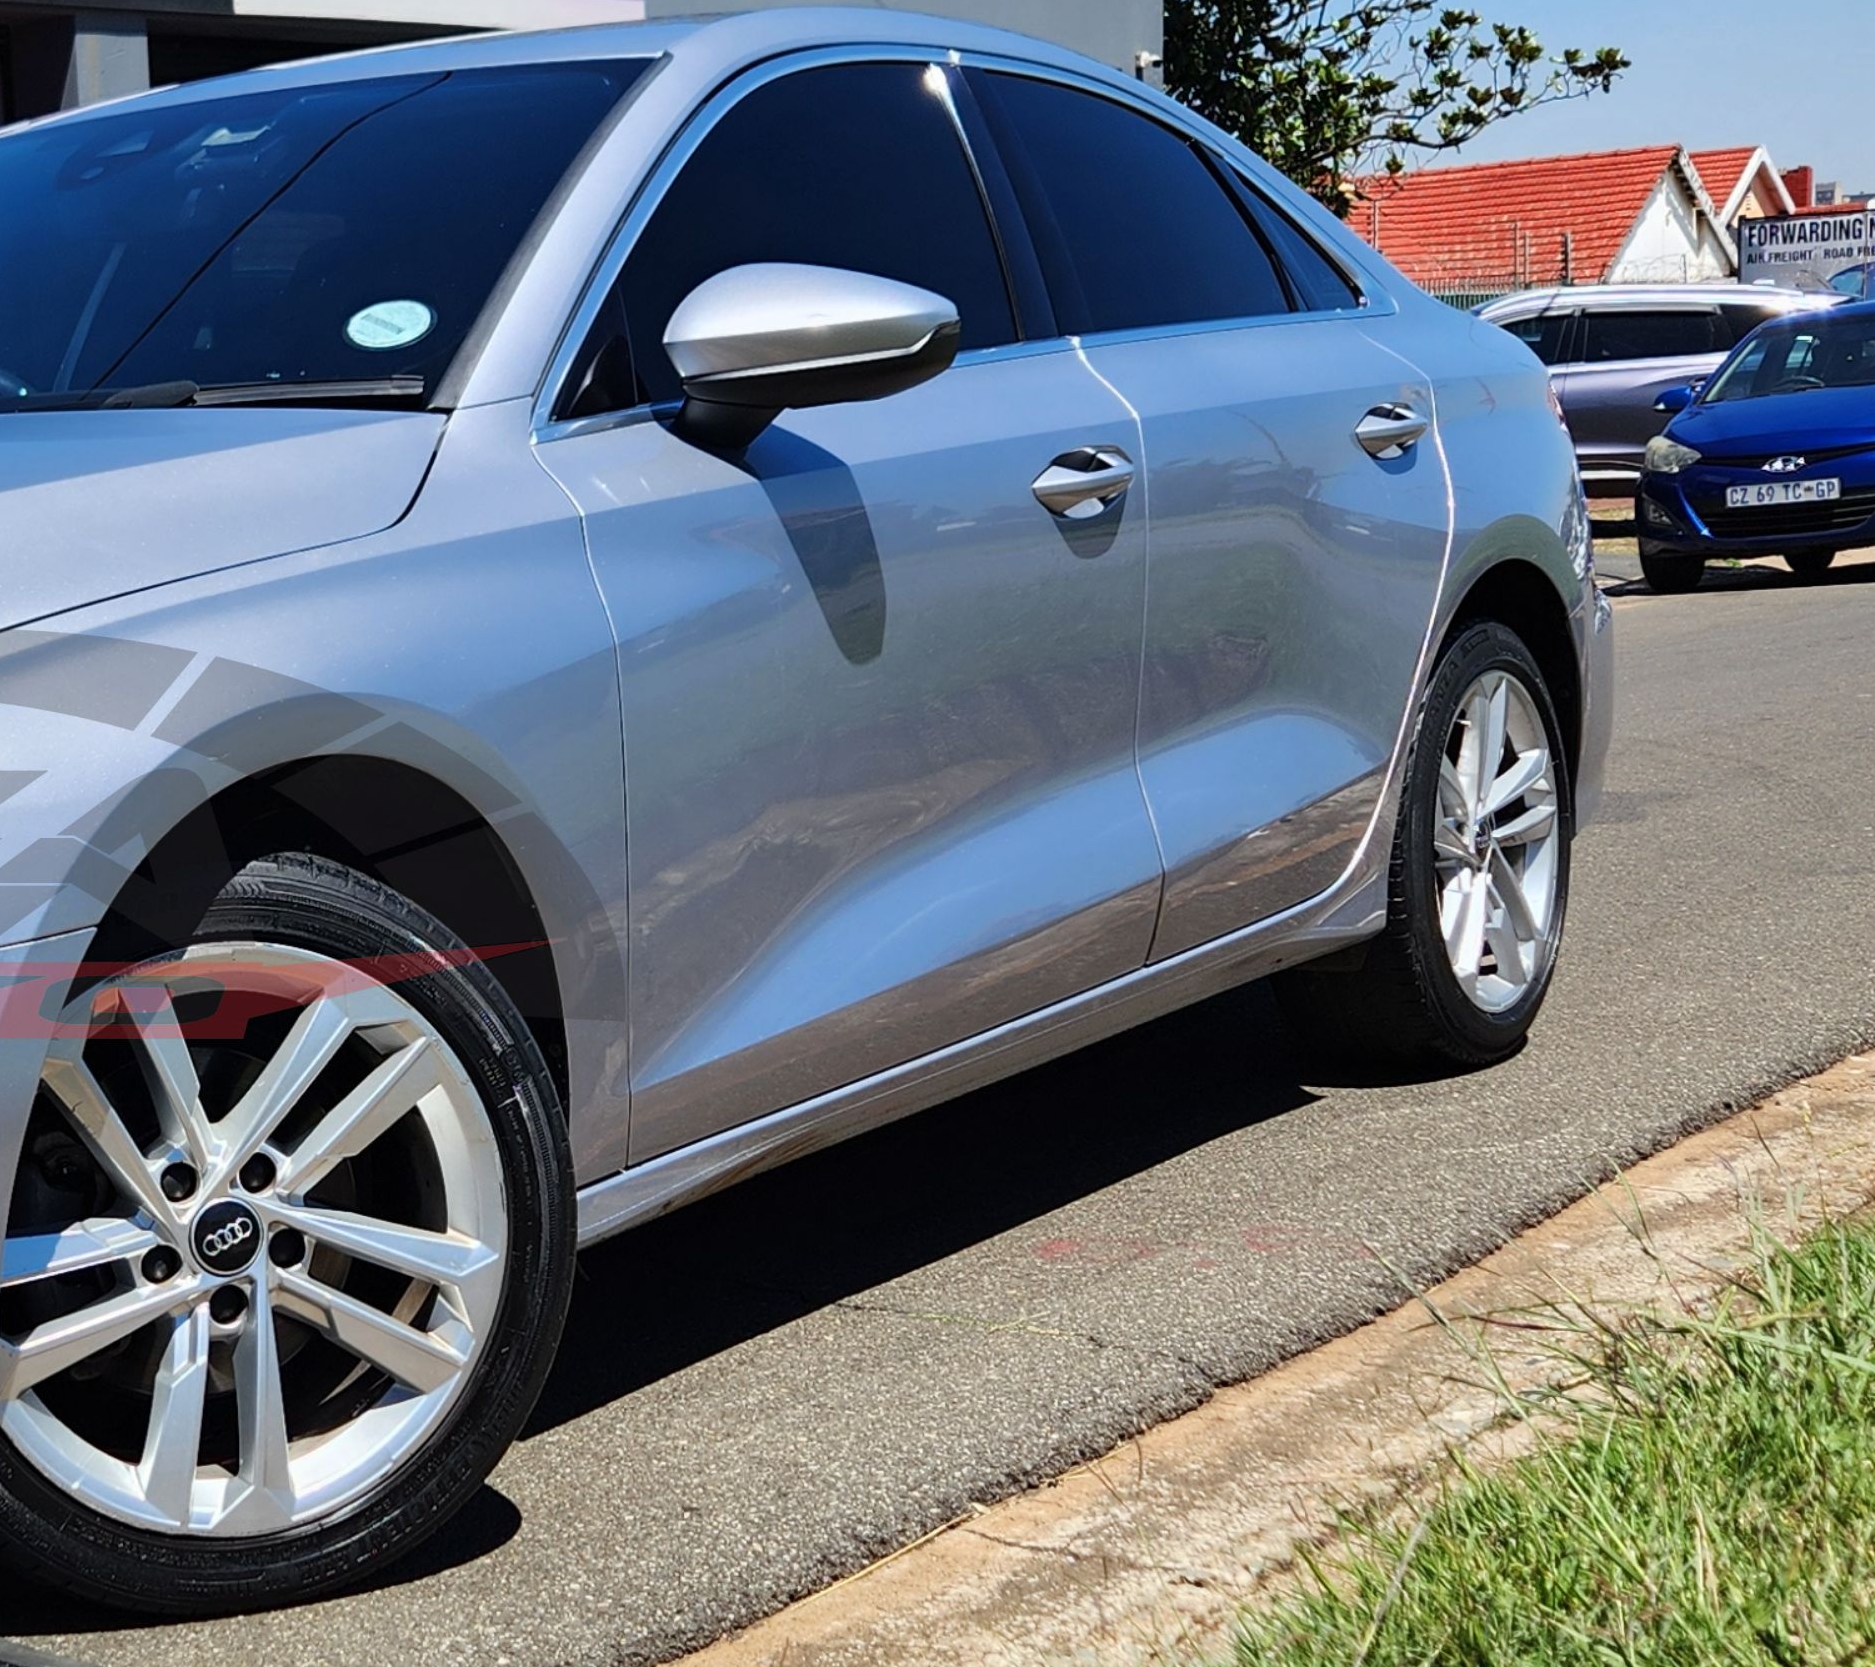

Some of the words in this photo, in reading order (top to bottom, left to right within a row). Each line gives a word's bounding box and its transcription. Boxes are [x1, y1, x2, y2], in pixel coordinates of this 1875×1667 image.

[1747, 218, 1864, 248] FORWARDING
[1768, 249, 1814, 264] FREIGHT
[1823, 246, 1854, 259] ROAD
[1730, 487, 1750, 506] CZ
[1756, 485, 1776, 503] 69
[1782, 482, 1802, 500] TC
[1815, 480, 1836, 499] GP
